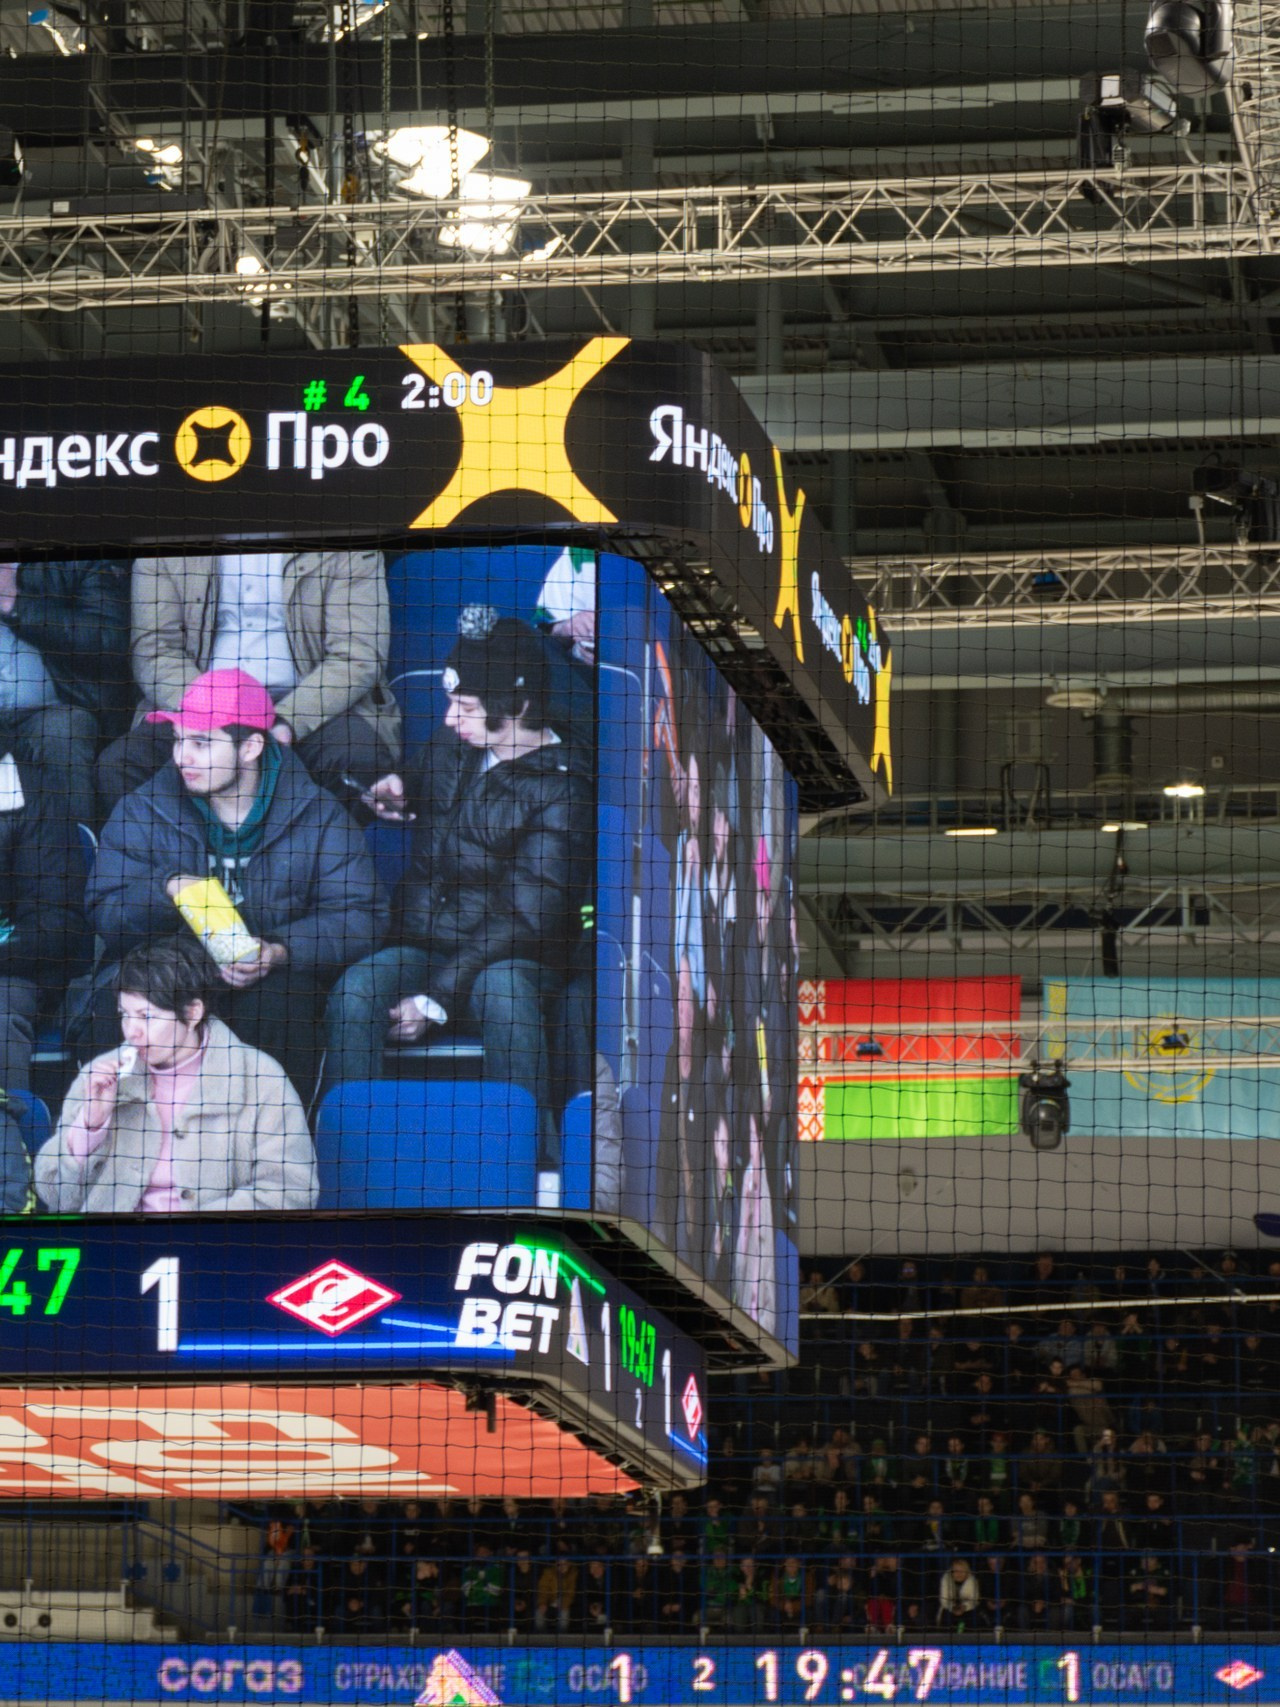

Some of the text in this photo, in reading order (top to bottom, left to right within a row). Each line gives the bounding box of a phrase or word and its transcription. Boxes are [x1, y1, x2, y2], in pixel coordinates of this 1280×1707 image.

[344, 375, 370, 411] 4
[401, 369, 493, 410] 2:00
[267, 411, 390, 480] Про
[649, 404, 738, 505] Яндекс
[454, 1241, 560, 1300] FON
[139, 1255, 180, 1353] 1
[453, 1296, 560, 1356] BET
[334, 1662, 506, 1692] СТРАХОИЕ
[568, 1663, 649, 1692] ОСАО
[610, 1652, 632, 1704] 1
[692, 1656, 717, 1692] 2
[755, 1649, 943, 1701] 19:47
[1056, 1651, 1080, 1703] 1
[1092, 1661, 1174, 1691] ОСАГО
